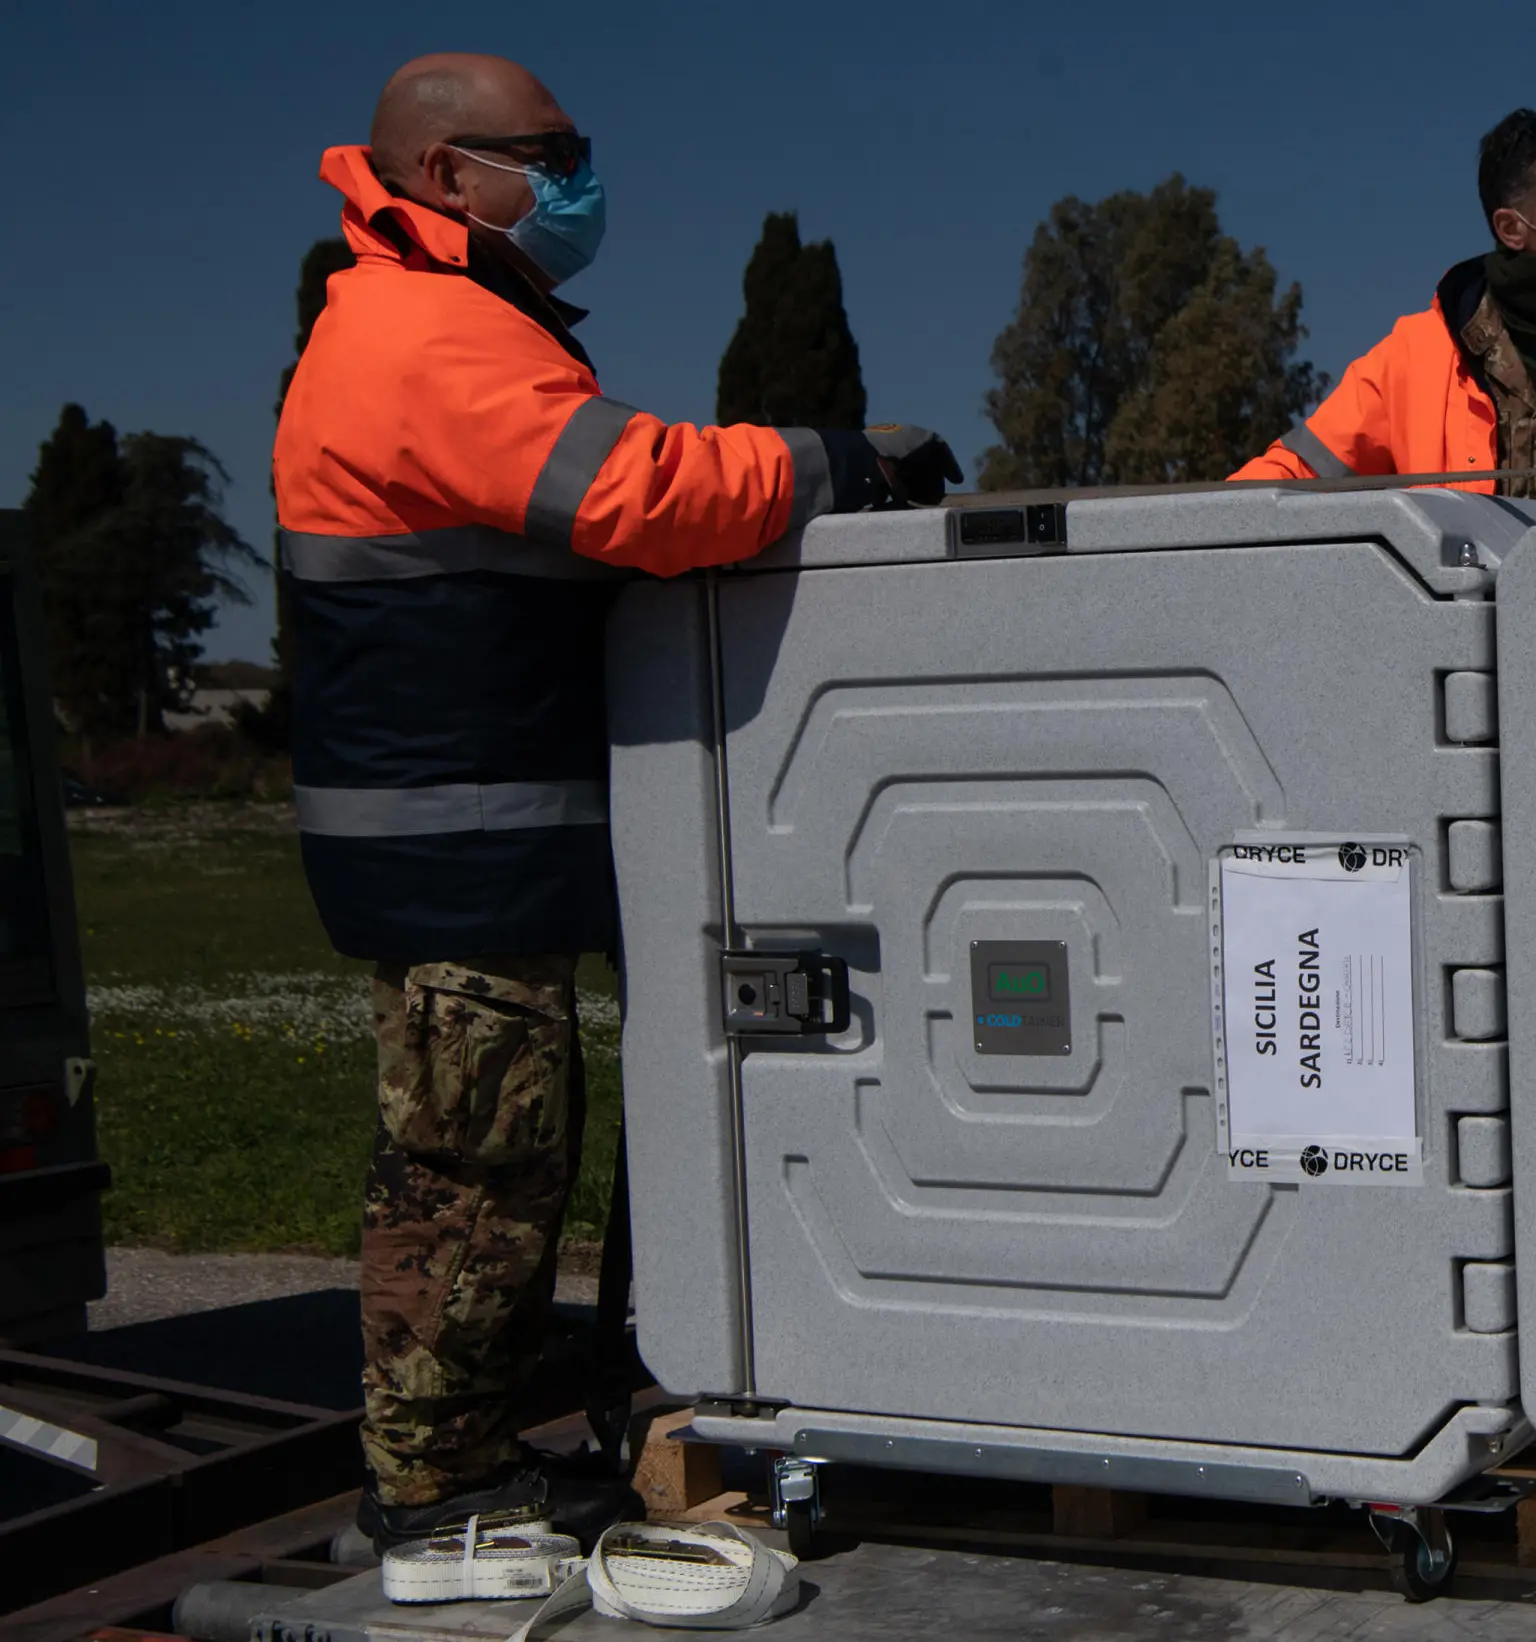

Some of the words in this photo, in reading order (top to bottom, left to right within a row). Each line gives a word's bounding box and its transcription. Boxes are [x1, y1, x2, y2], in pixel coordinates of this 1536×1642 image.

[1234, 845, 1306, 863] DRYCE
[1255, 958, 1277, 1056] SICILIA
[1298, 928, 1321, 1089] SARDEGNA
[1334, 1152, 1408, 1172] DRYCE
